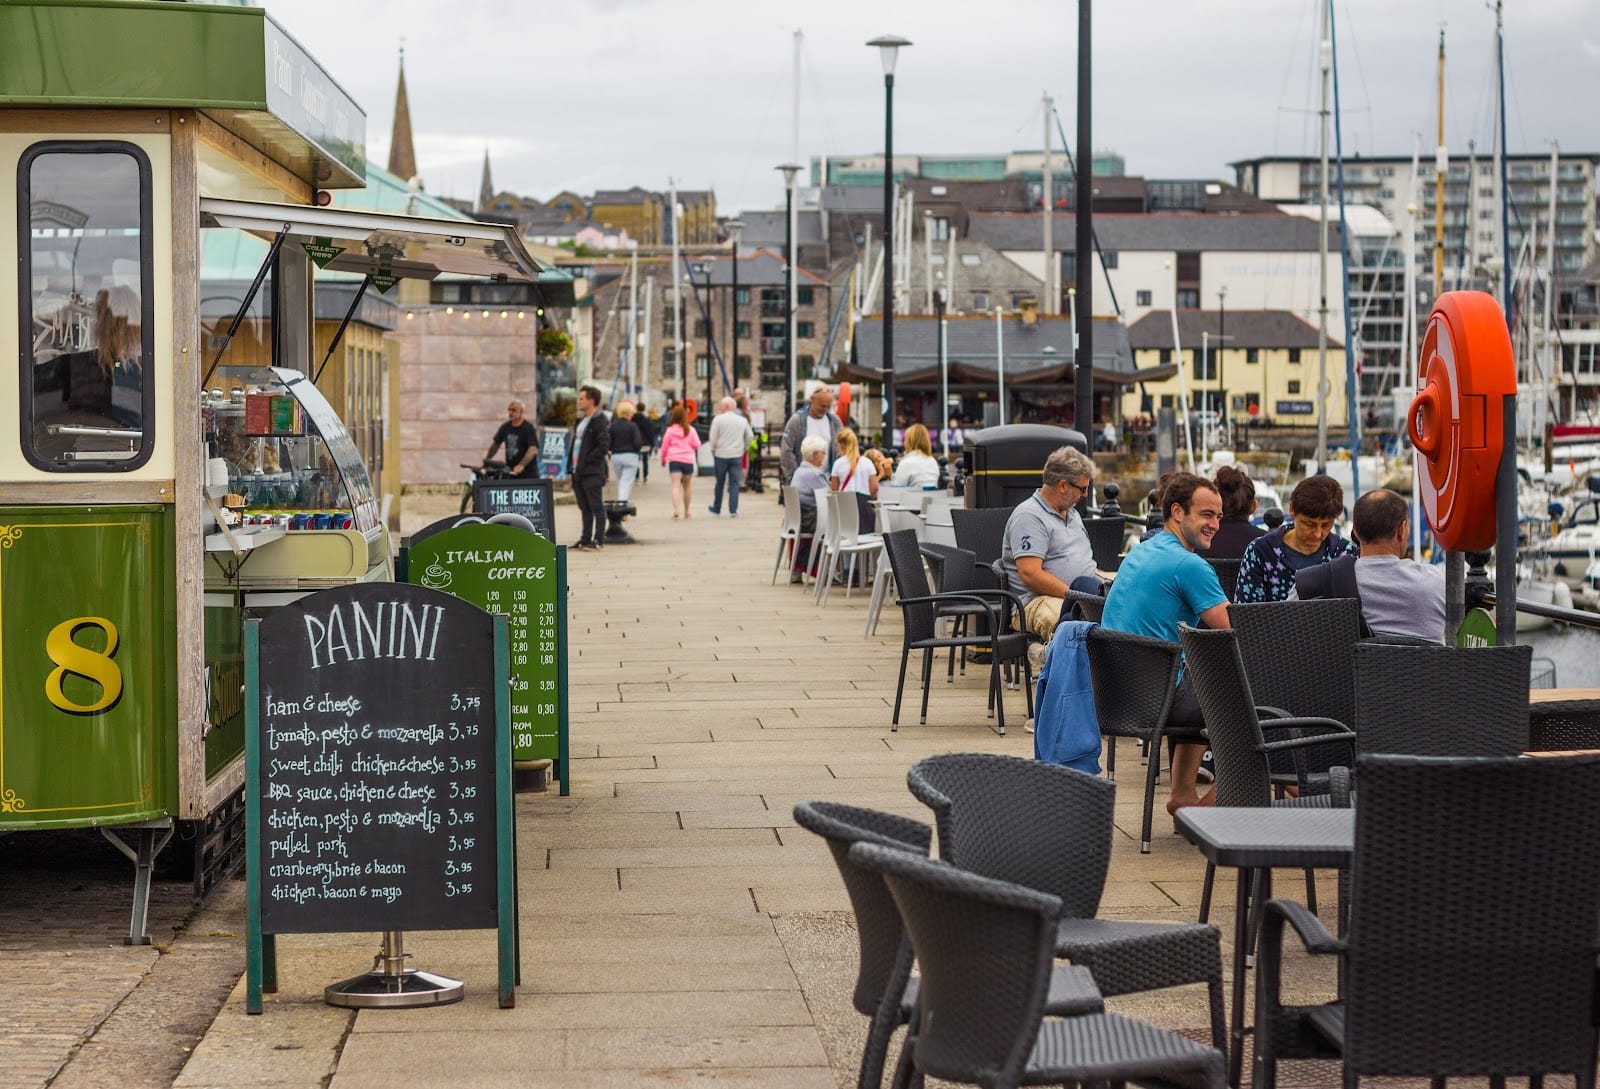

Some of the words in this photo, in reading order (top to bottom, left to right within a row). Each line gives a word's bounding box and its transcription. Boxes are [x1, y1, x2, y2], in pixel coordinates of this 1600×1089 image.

[489, 490, 509, 505] THE
[512, 489, 541, 505] GREEK
[1021, 536, 1031, 551] 3
[446, 550, 514, 564] ITALIAN
[487, 567, 546, 580] COFFEE
[487, 591, 500, 602] 1,20
[513, 590, 527, 601] 1,50
[486, 604, 501, 614] 2,00
[513, 603, 528, 614] 2,40
[539, 602, 554, 614] 2,70
[513, 616, 528, 627] 2,40
[539, 615, 554, 627] 2,70
[303, 600, 446, 669] PANINI
[514, 629, 527, 640] 2,10
[539, 628, 555, 640] 2,40
[513, 642, 528, 653] 2,80
[539, 641, 555, 653] 3,20
[46, 616, 124, 716] 8
[514, 655, 527, 666] 1,60
[540, 654, 554, 666] 1,80
[513, 680, 529, 692] 2,80
[540, 680, 555, 692] 3,20
[266, 694, 300, 717] ham
[303, 694, 315, 711] &
[317, 691, 362, 718] cheese
[450, 692, 481, 712] 3,75
[512, 704, 529, 714] REAM
[537, 703, 555, 716] 0,30
[512, 721, 532, 731] ROM
[321, 720, 358, 754] pesto
[361, 723, 373, 739] &
[378, 723, 445, 746] mozzarella
[448, 721, 479, 741] 3,75
[313, 750, 344, 777] chilli
[449, 755, 477, 774] 3,95
[269, 781, 293, 801] BBQ
[297, 786, 338, 803] sauce,
[398, 781, 437, 804] cheese
[449, 781, 477, 800] 3,95
[324, 808, 359, 834] pesto
[362, 811, 373, 825] &
[378, 806, 441, 834] mozzarella
[447, 808, 475, 827] 3,95
[269, 830, 311, 859] pulled
[317, 834, 349, 859] pork
[448, 835, 476, 852] 3,95
[364, 862, 373, 875] &
[374, 859, 407, 875] bacon
[445, 860, 473, 876] 3,95
[322, 884, 357, 899] bacon
[359, 885, 368, 897] &
[371, 886, 403, 904] mayo
[445, 881, 473, 897] 3,95
